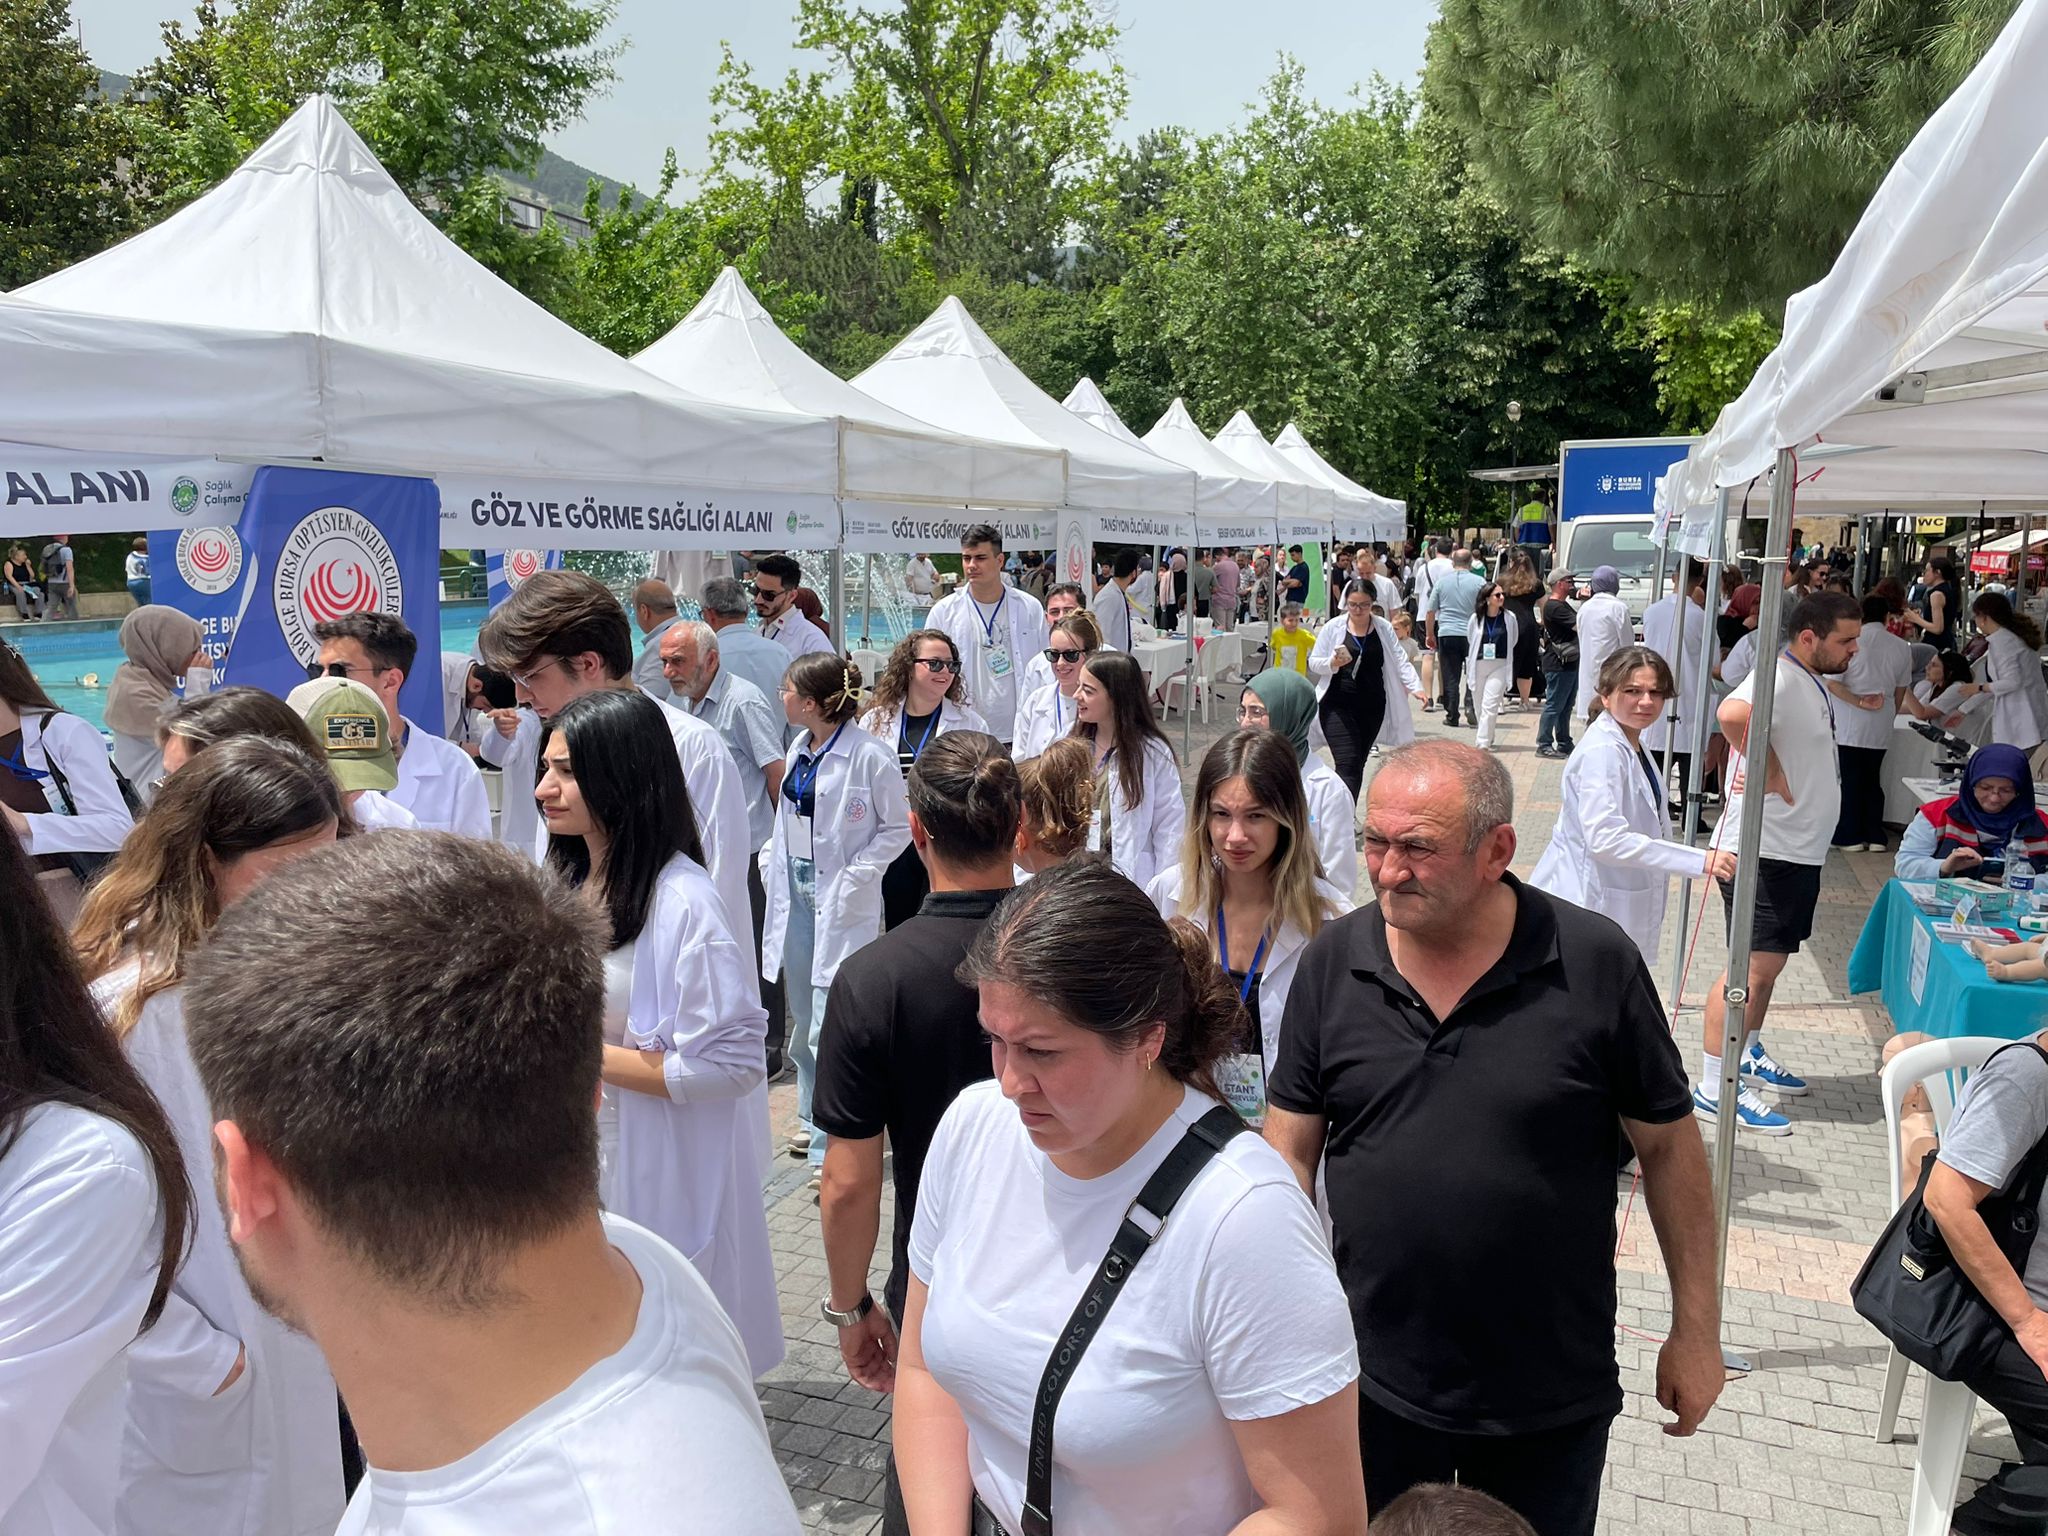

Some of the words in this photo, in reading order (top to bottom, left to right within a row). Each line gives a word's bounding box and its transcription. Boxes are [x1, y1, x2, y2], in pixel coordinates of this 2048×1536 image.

[6, 469, 149, 505] ALANI
[204, 480, 233, 492] Sağlık
[204, 493, 241, 507] Çalışma
[471, 491, 526, 527] GÖZ
[527, 502, 562, 528] VE
[565, 496, 643, 530] GÖRME
[647, 501, 719, 532] SAĞLIĞI
[723, 509, 772, 533] ALANI
[1917, 517, 1944, 527] WC
[892, 516, 914, 539] GÖZ
[916, 522, 930, 539] VE
[1005, 523, 1030, 539] ALANI
[1101, 515, 1130, 533] TANSİYON
[280, 549, 301, 601] BURSA
[1224, 1083, 1256, 1095] STANT
[1034, 1412, 1047, 1480] UNITED
[1043, 1323, 1086, 1406] COLORS
[1084, 1287, 1106, 1319] OF
